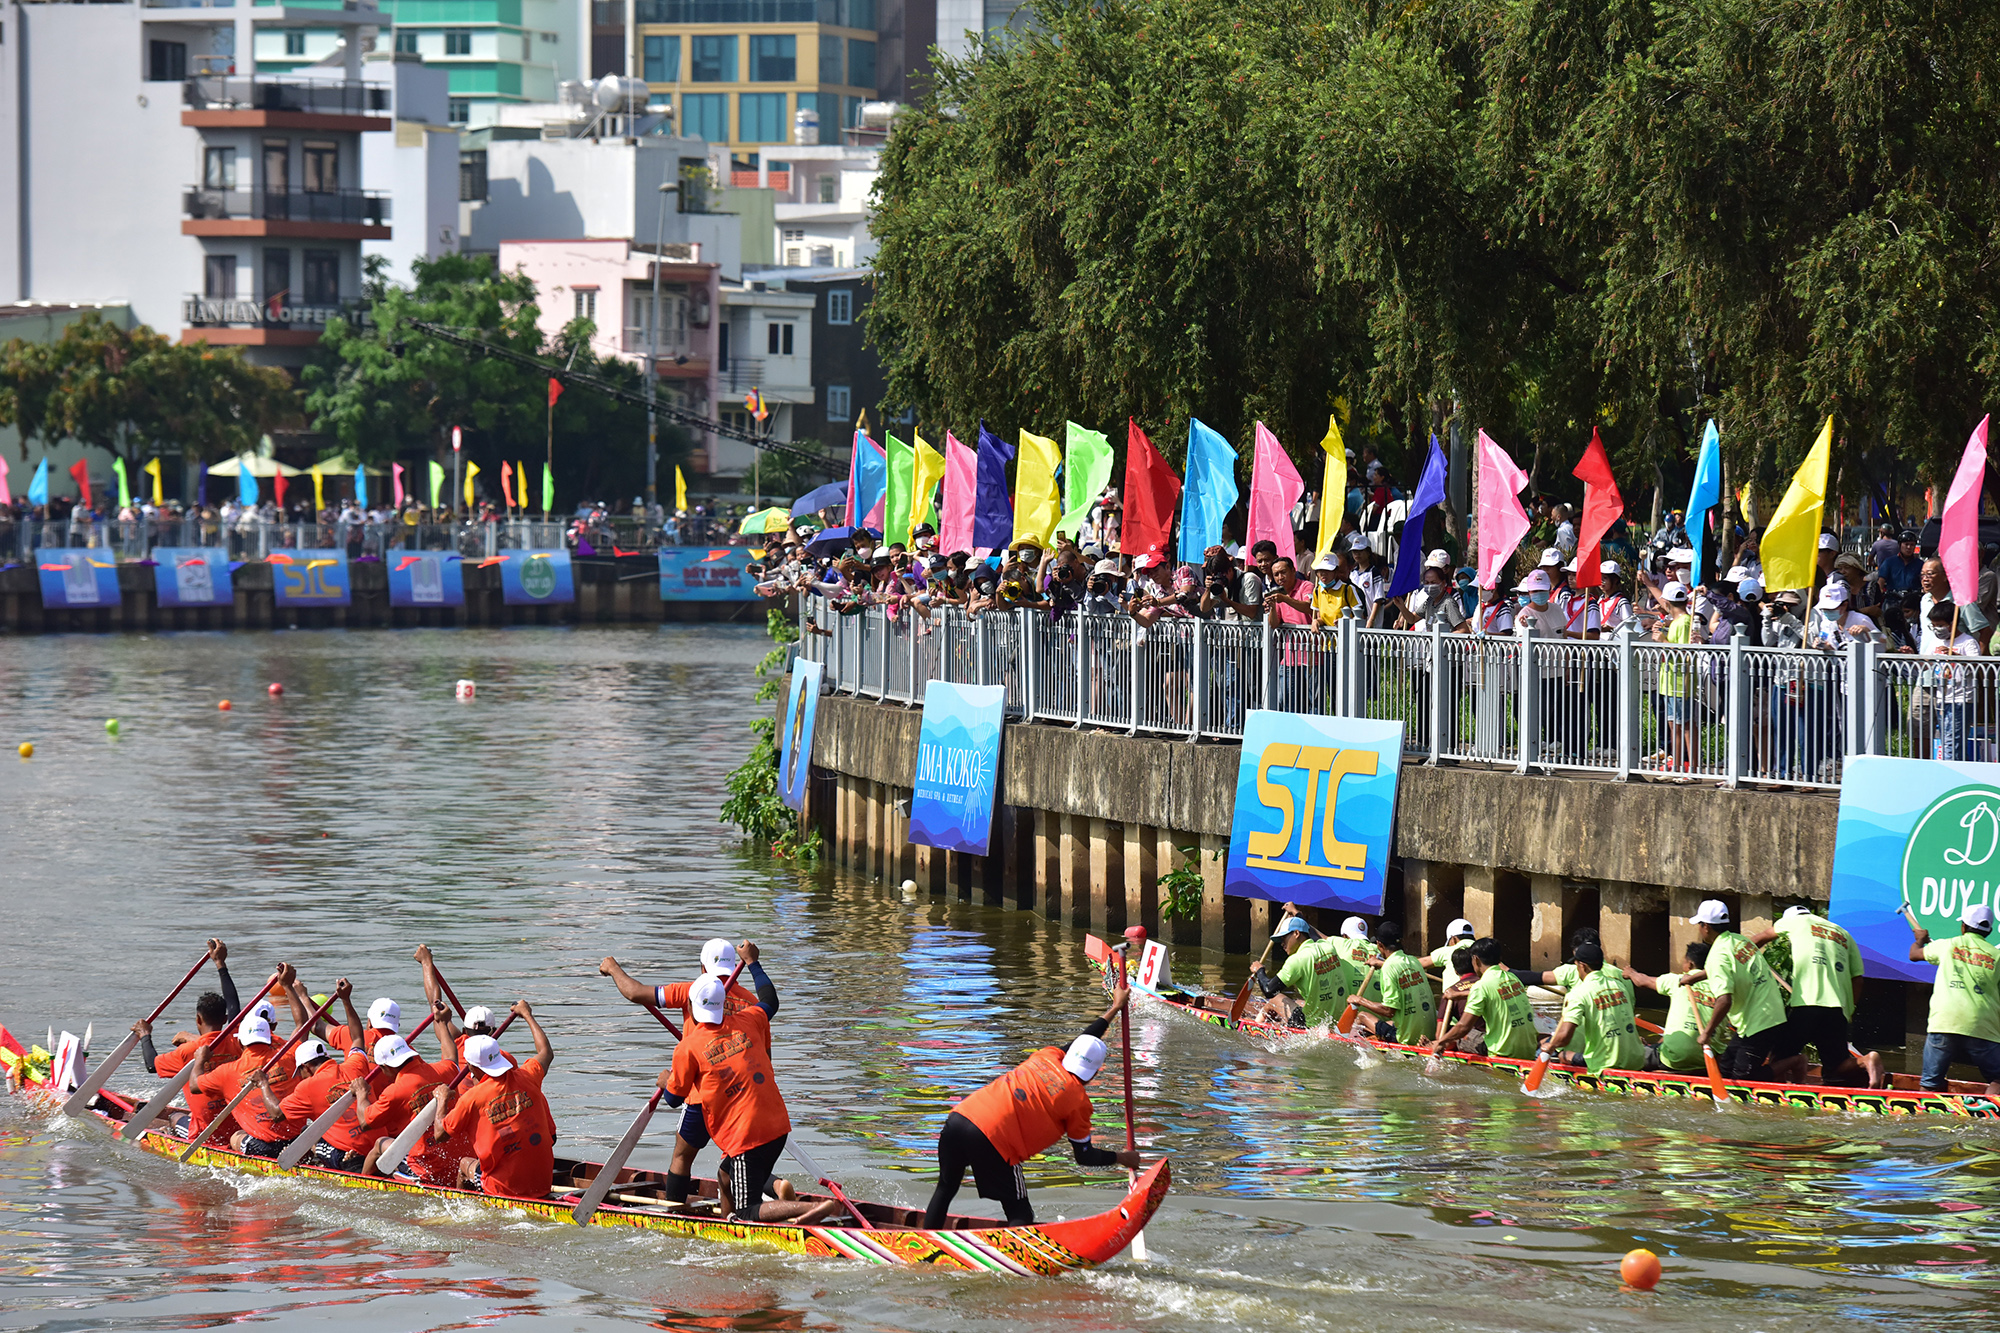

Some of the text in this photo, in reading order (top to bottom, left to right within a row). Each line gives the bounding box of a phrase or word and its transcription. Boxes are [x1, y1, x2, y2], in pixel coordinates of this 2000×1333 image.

[283, 559, 342, 597] STC
[464, 685, 473, 697] 3
[919, 743, 982, 788] IMA KOKO
[1247, 742, 1379, 873] STC
[1920, 876, 1975, 918] DUY
[1144, 945, 1158, 986] 5
[725, 1081, 745, 1098] STC
